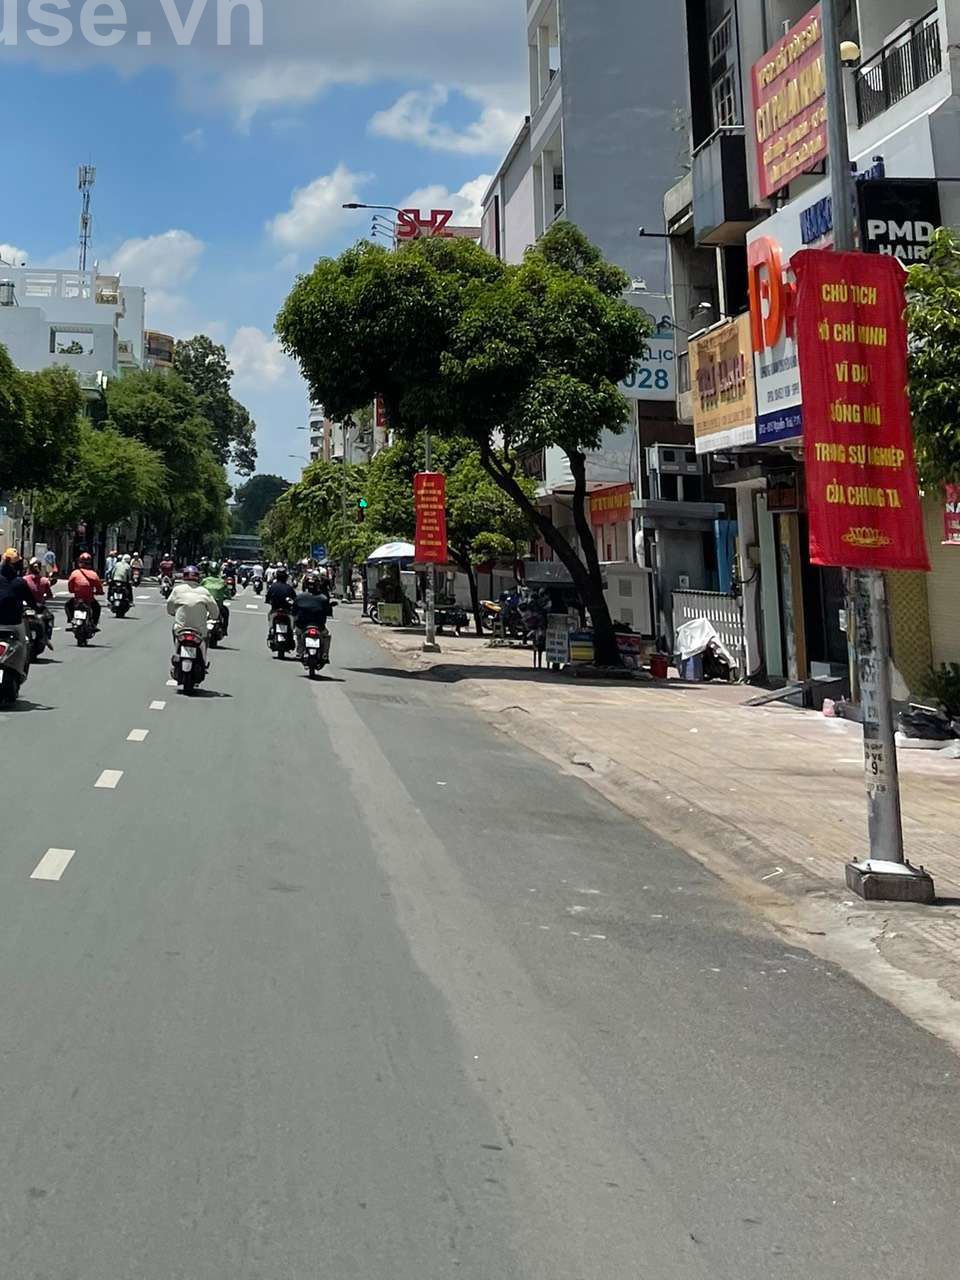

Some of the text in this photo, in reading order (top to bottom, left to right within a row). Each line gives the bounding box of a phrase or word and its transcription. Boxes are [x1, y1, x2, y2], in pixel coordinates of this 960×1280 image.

[867, 219, 934, 242] PMD
[879, 244, 928, 261] HAIR
[822, 279, 848, 302] CHỦ
[833, 320, 855, 342] CHÍ
[815, 442, 846, 464] TRNG
[826, 478, 846, 504] CỦA
